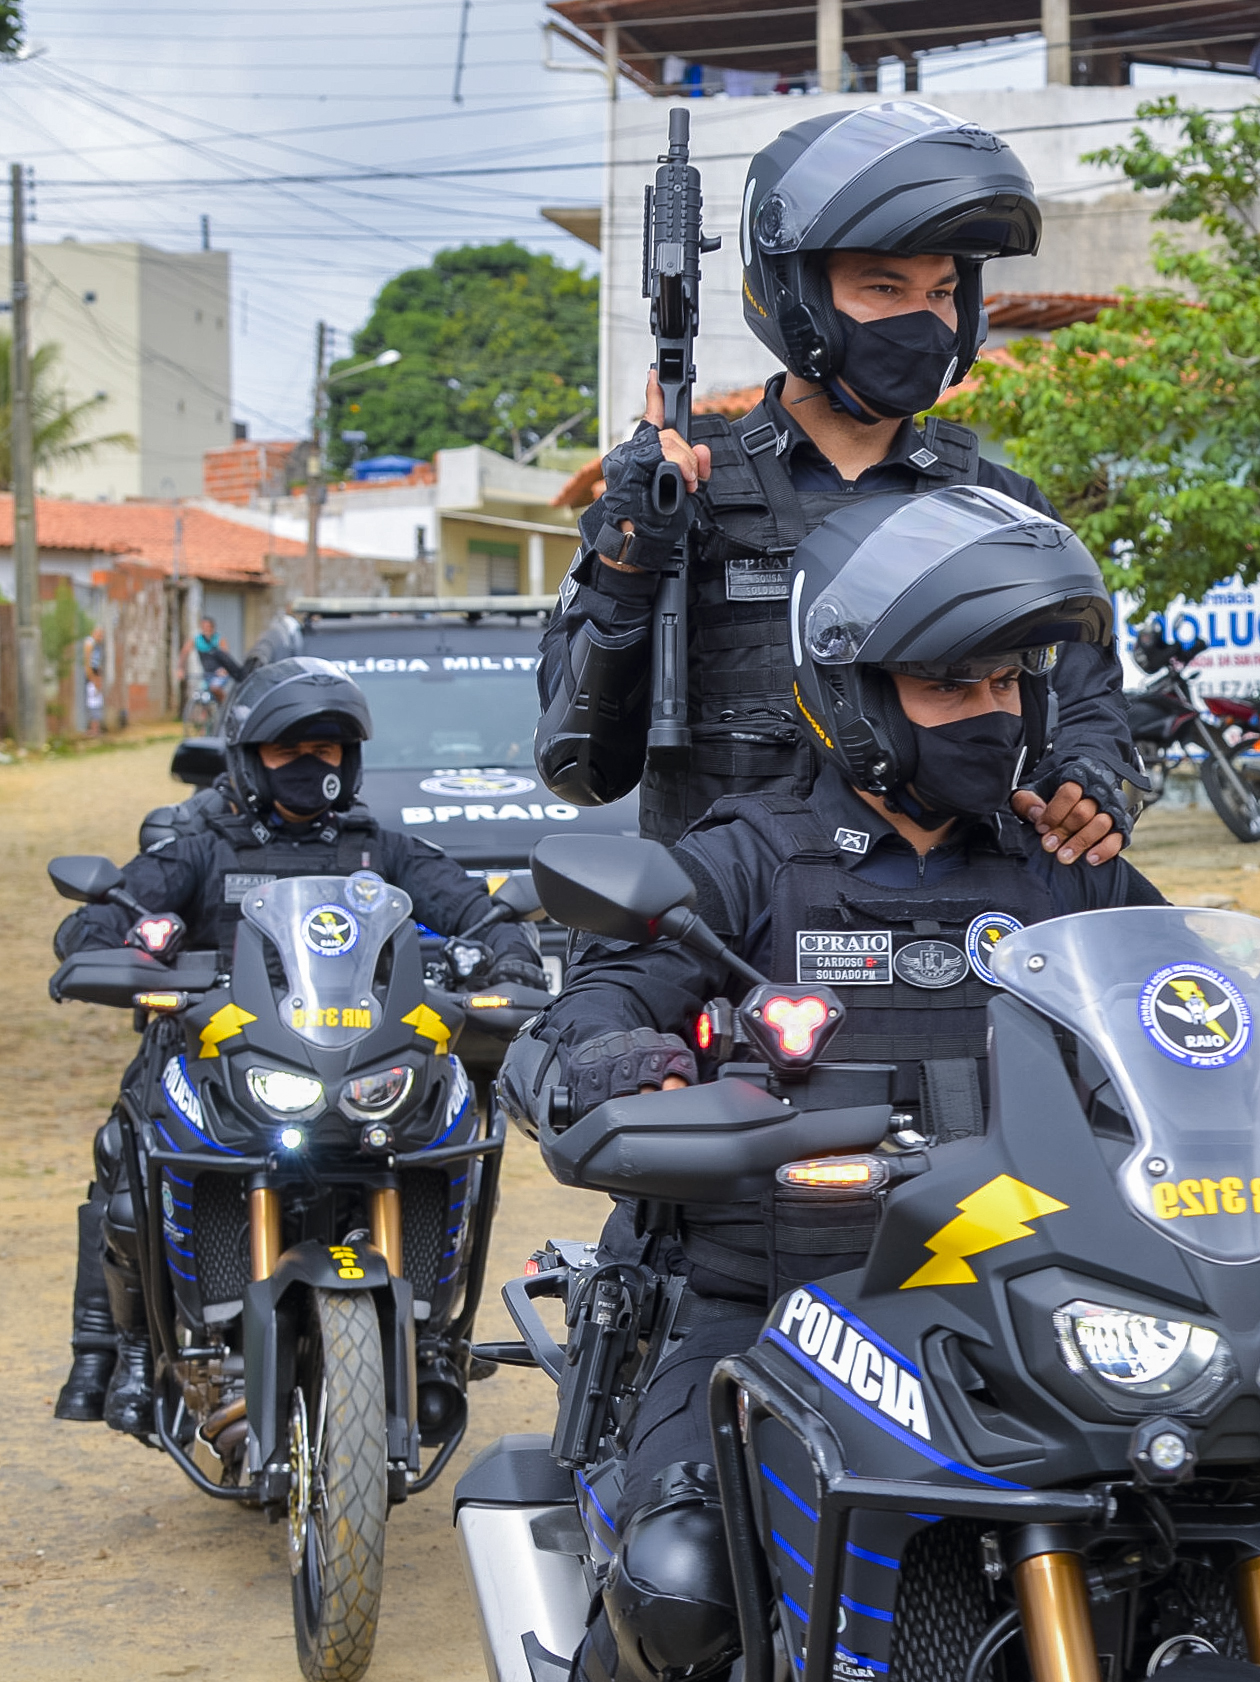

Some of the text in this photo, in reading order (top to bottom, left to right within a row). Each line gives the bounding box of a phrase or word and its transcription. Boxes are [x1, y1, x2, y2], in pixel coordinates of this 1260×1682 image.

[729, 557, 792, 571] CPRAI
[401, 803, 579, 825] BPRAIO
[800, 935, 888, 951] CPRAIO
[816, 957, 863, 968] CARDOSO
[816, 970, 876, 980] SOLDADO PM
[1184, 1034, 1225, 1048] RAIO
